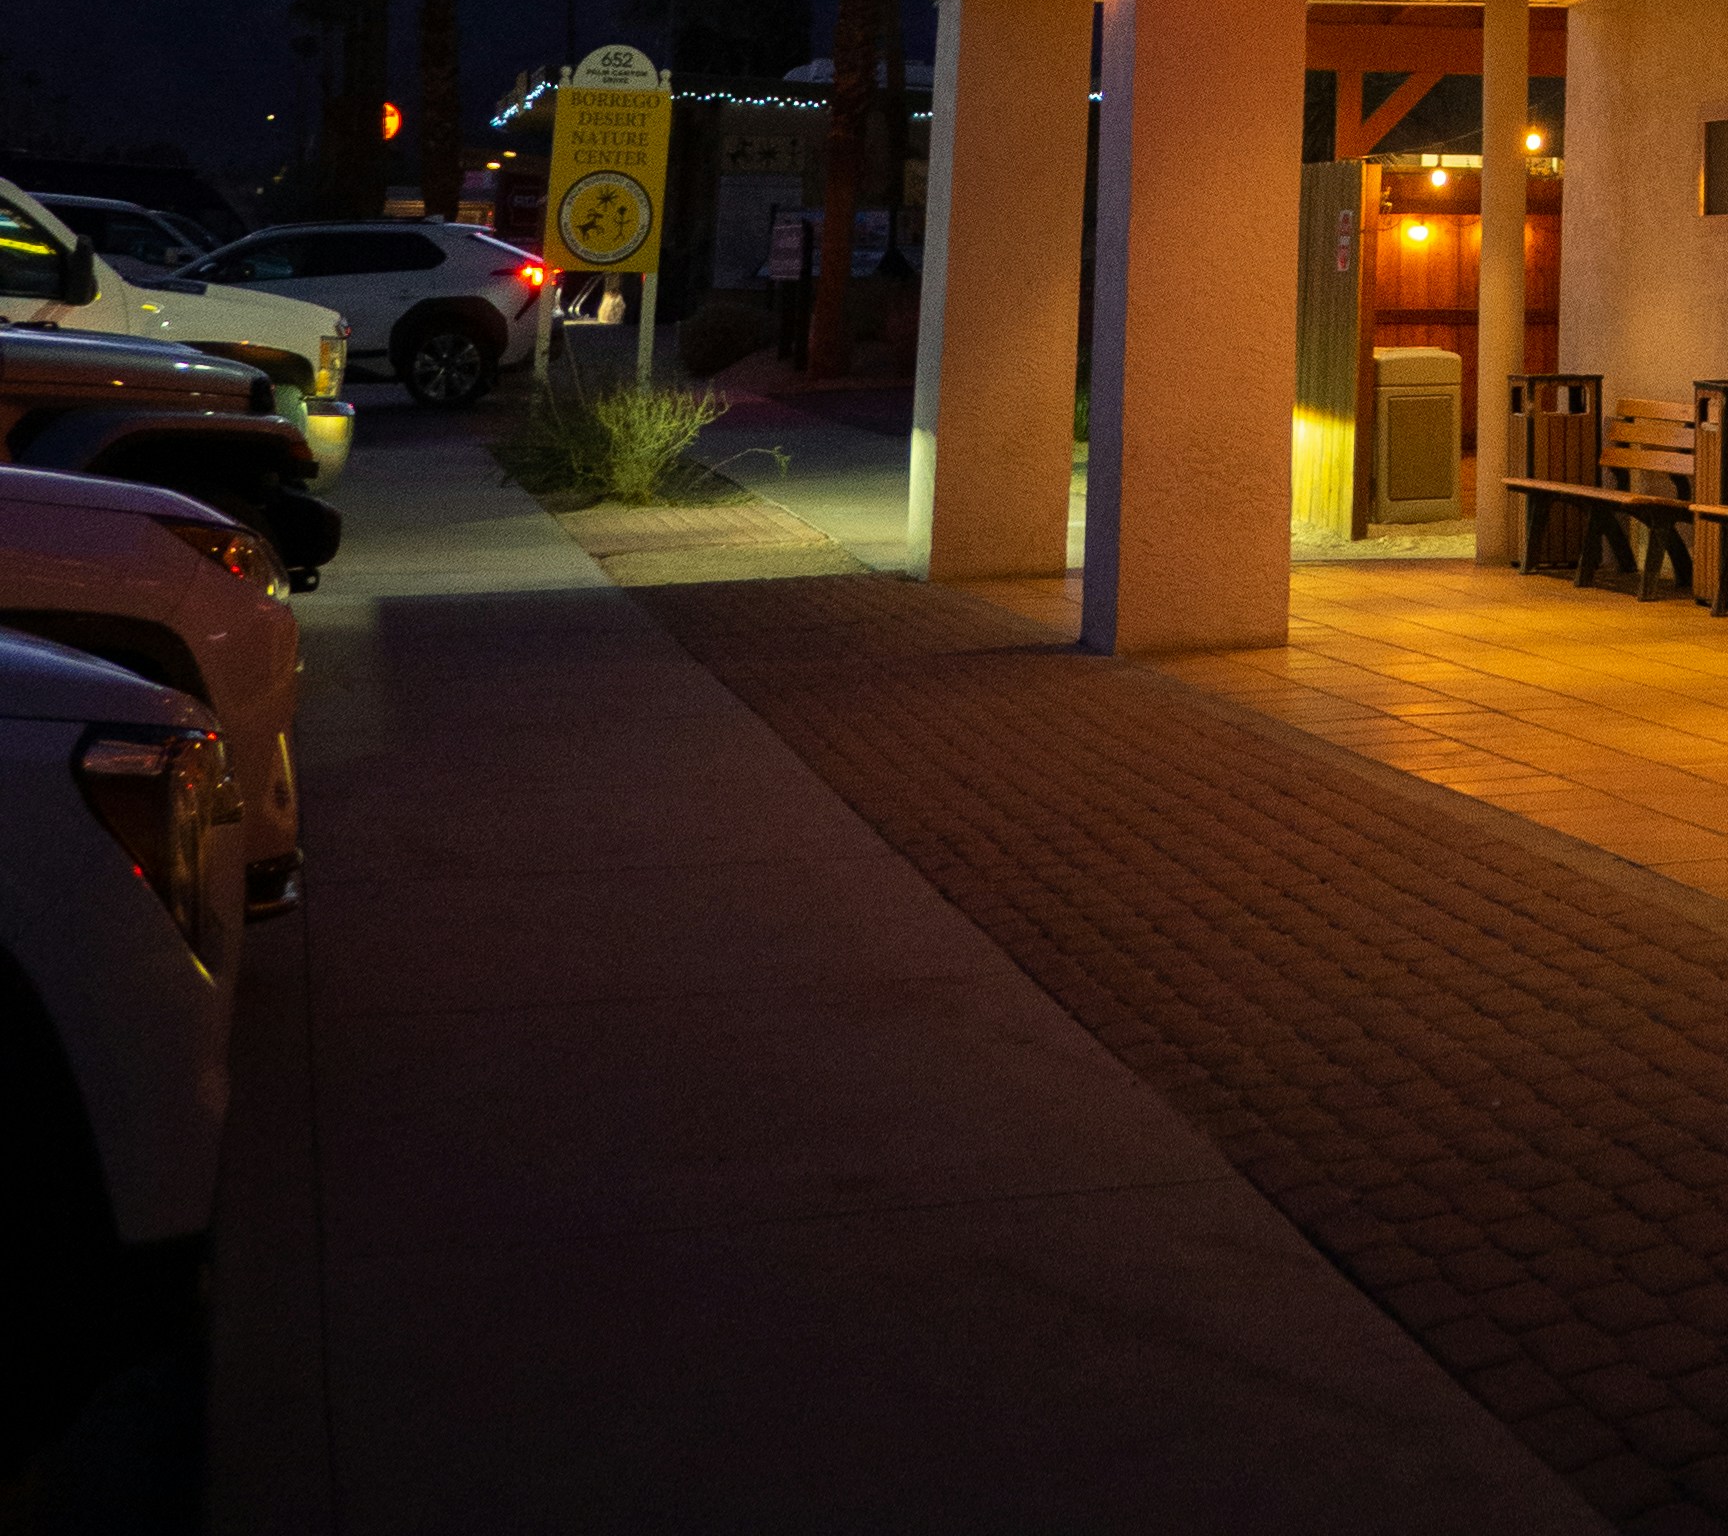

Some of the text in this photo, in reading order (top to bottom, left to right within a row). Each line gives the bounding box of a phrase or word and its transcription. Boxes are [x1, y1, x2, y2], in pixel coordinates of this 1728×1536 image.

[601, 51, 634, 68] 652
[571, 91, 661, 108] BORREGO
[578, 110, 648, 127] DESERT
[570, 130, 650, 147] NATURE
[573, 148, 648, 166] CENTER
